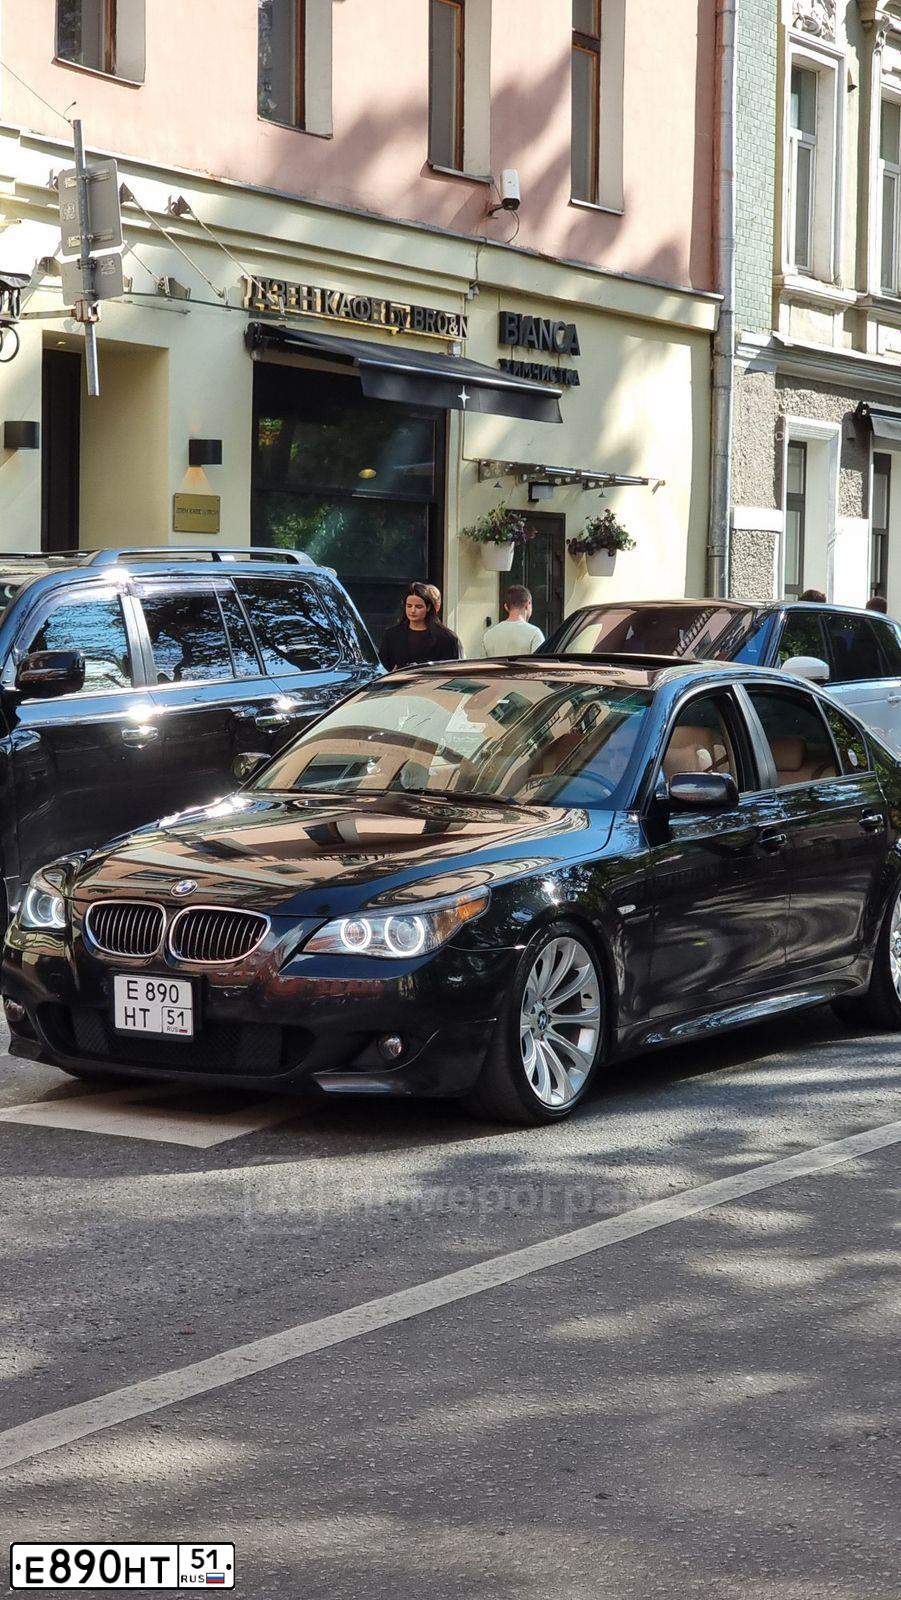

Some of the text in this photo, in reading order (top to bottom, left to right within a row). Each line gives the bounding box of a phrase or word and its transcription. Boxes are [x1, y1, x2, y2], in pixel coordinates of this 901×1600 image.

[499, 311, 580, 356] BIANCA
[145, 982, 179, 1004] 890
[166, 1009, 185, 1027] 51
